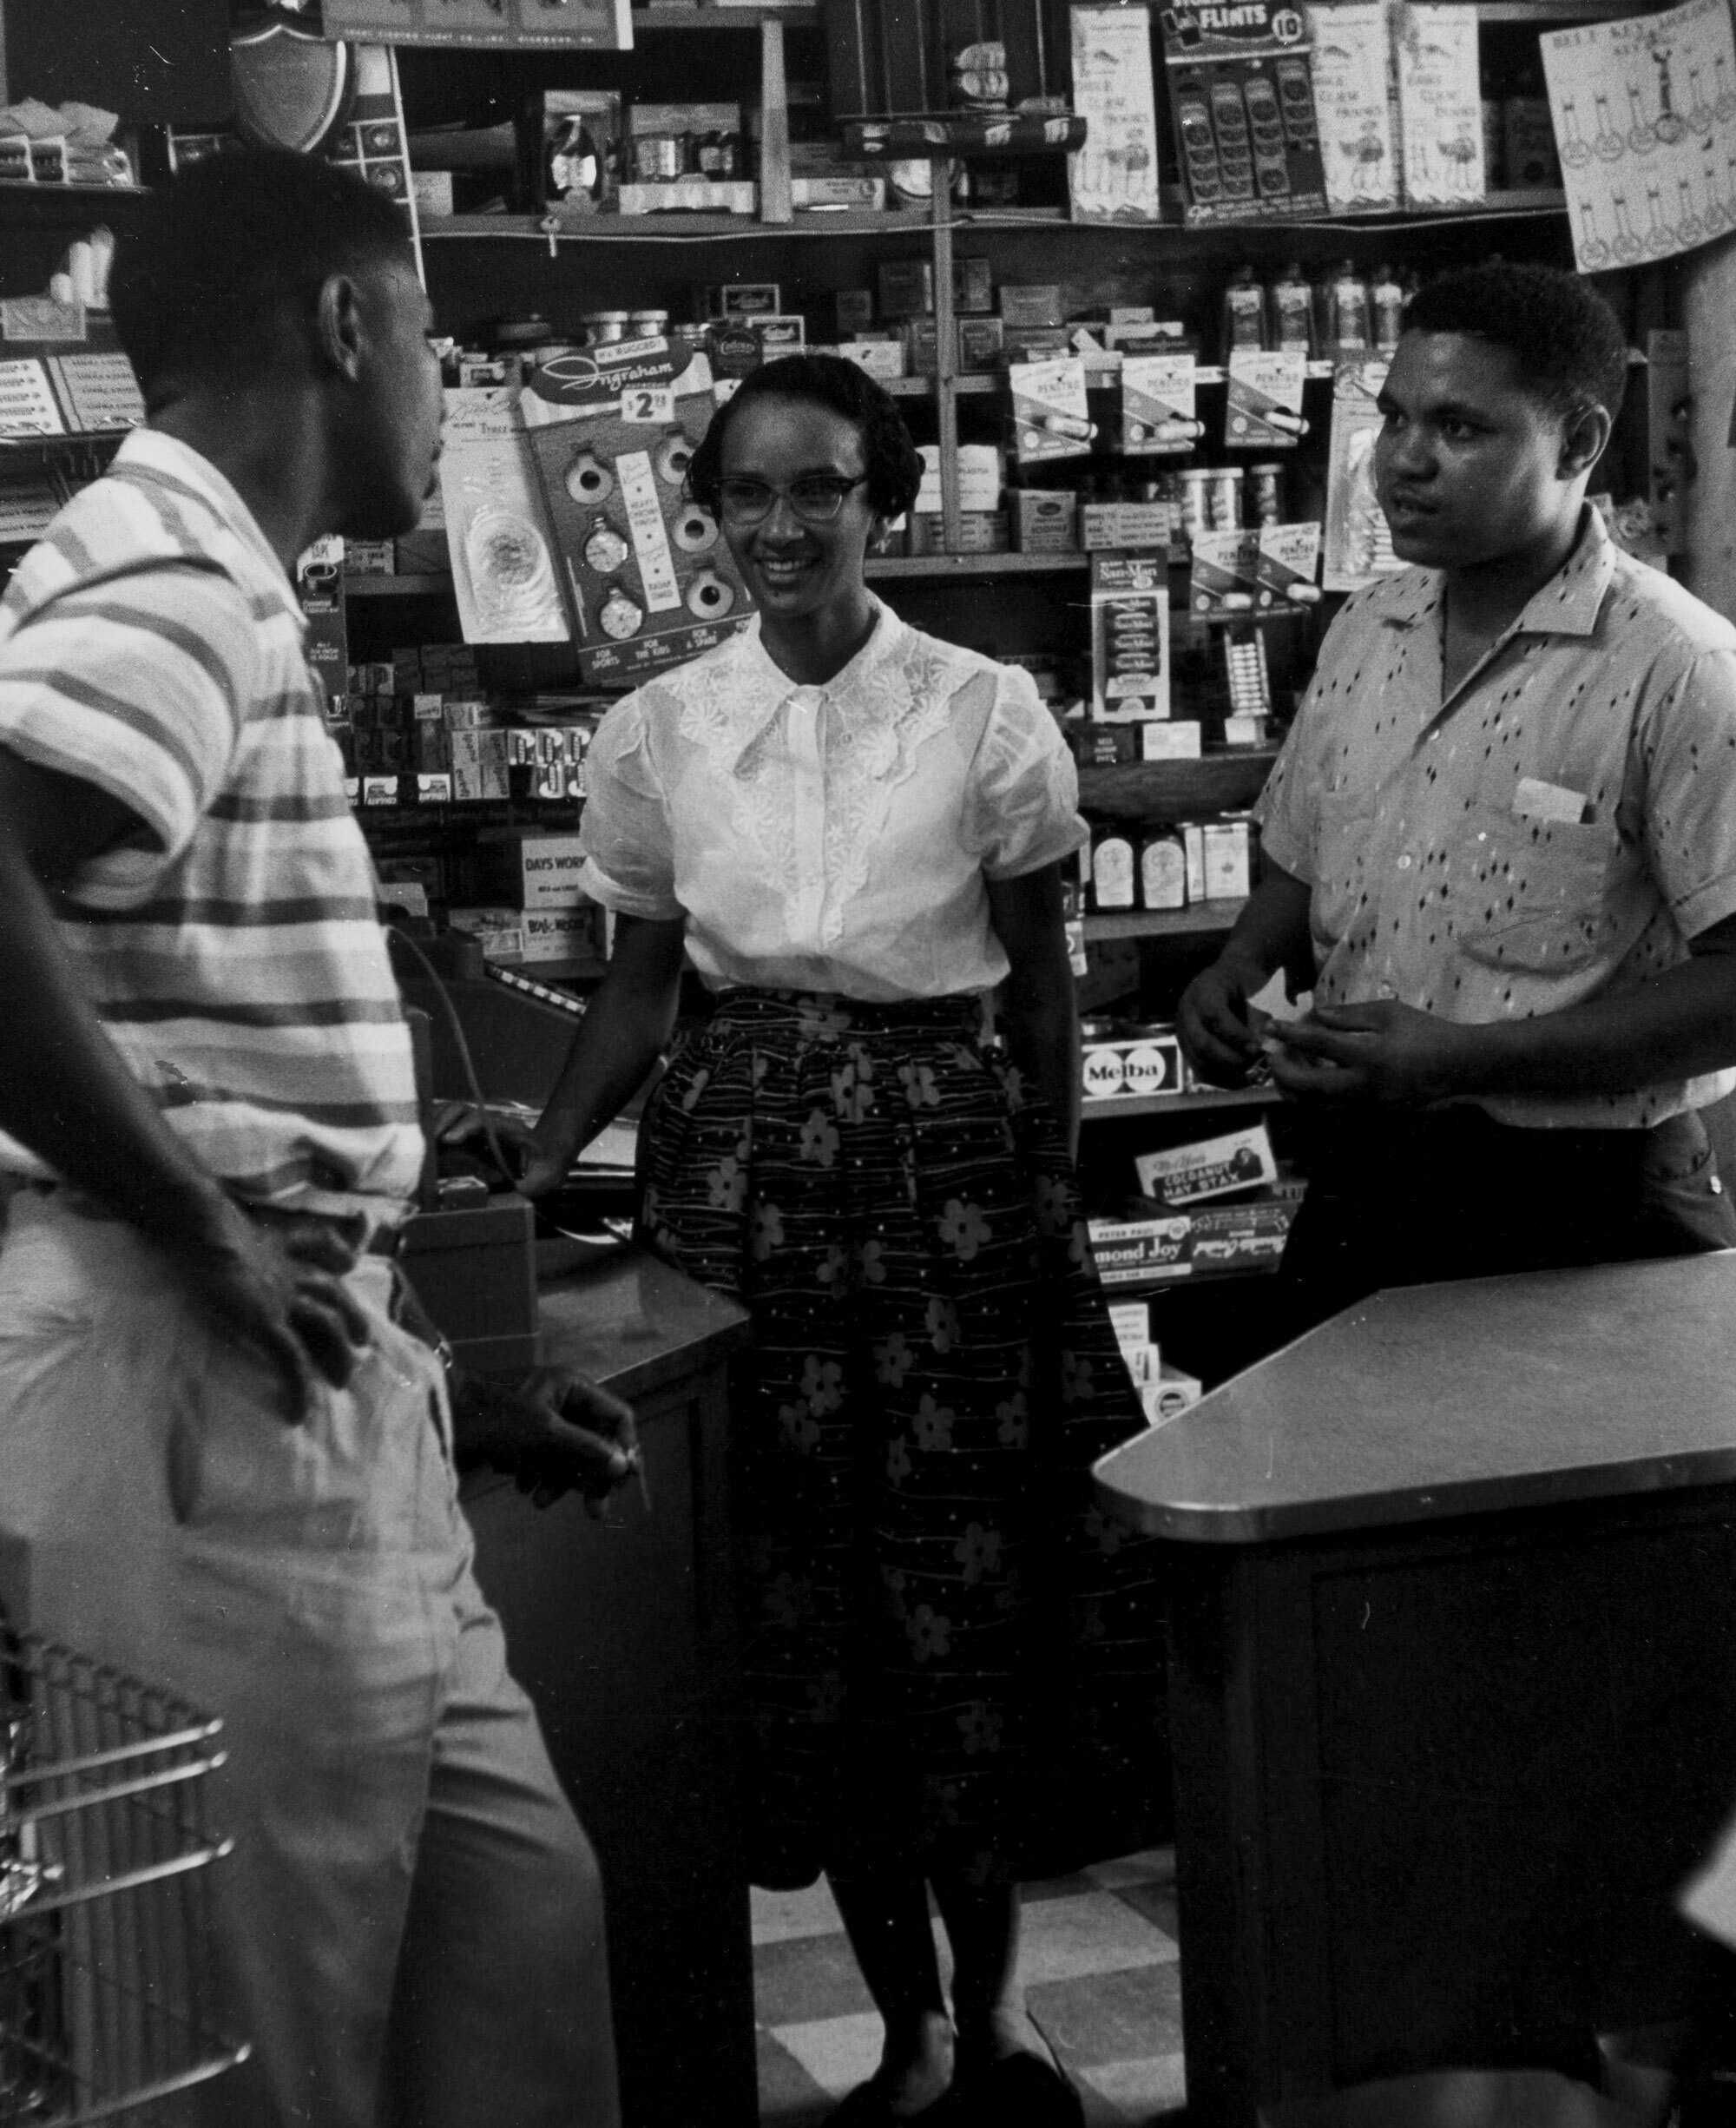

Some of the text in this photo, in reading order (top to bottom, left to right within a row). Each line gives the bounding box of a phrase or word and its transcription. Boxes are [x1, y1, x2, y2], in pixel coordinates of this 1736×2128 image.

[1200, 4, 1268, 29] FLINTS
[1278, 17, 1299, 36] 10
[542, 356, 674, 392] Ingraham
[366, 796, 397, 806] COLGATE
[526, 857, 554, 872] DAYS
[1088, 1063, 1159, 1080] Melba
[1199, 1172, 1240, 1190] STAX
[1097, 1228, 1154, 1240] PETER PAUL
[1095, 1242, 1145, 1263] mond
[1149, 1236, 1181, 1261] Joy
